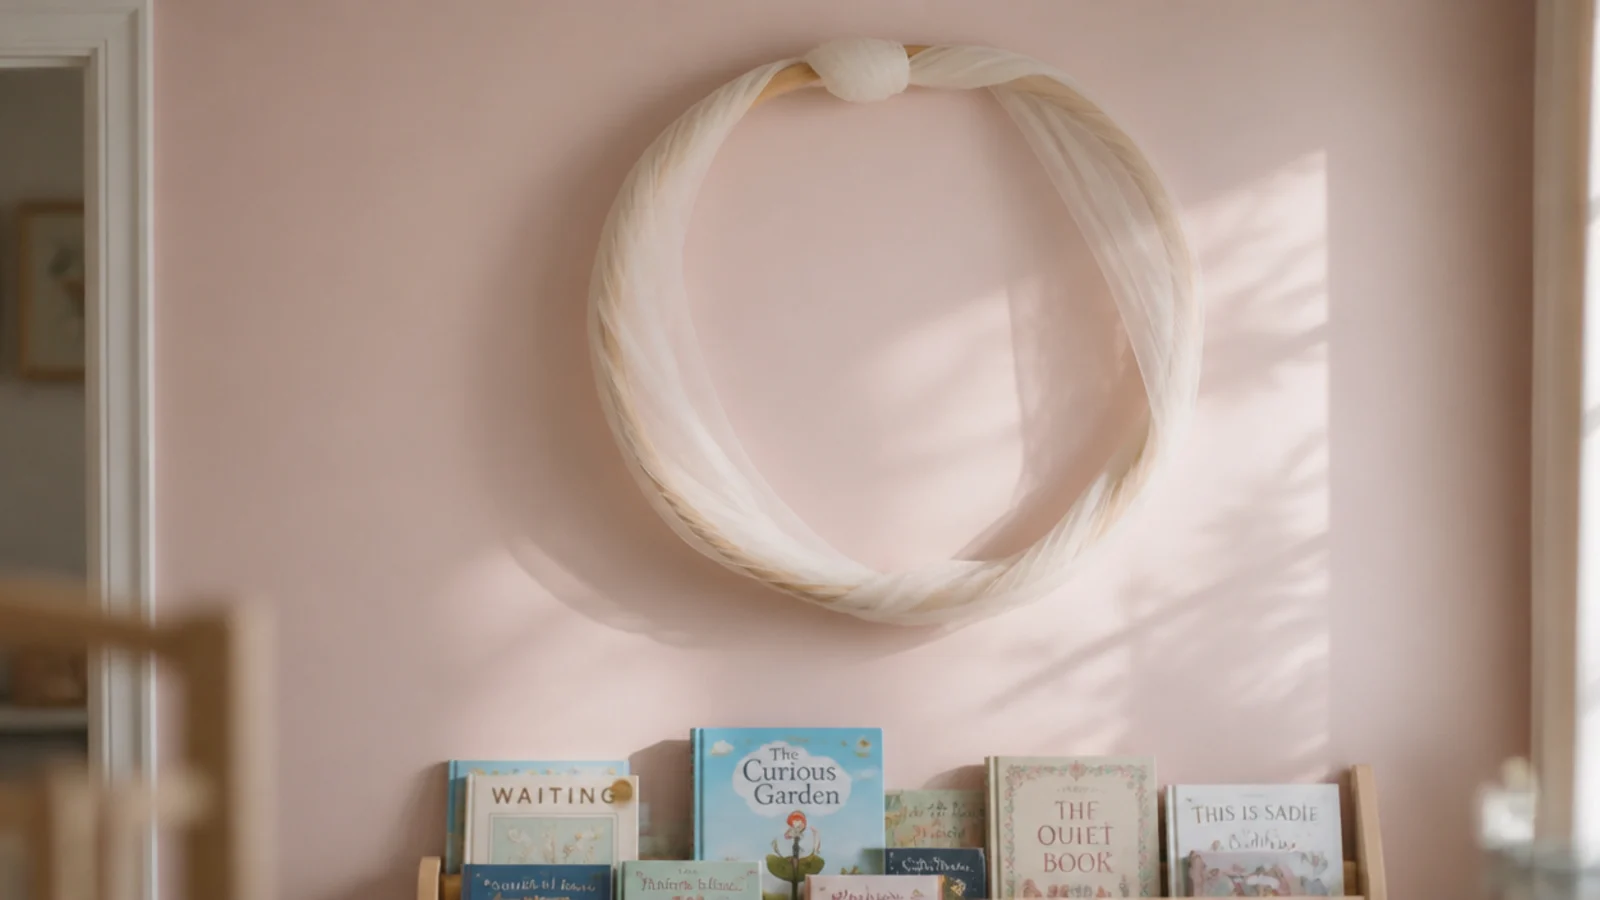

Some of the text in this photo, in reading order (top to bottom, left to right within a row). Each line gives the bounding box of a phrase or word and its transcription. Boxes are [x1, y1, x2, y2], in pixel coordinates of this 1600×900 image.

[769, 747, 799, 760] The
[743, 758, 837, 782] Curious
[492, 787, 616, 804] WAITING
[753, 783, 840, 806] Garden
[1054, 800, 1099, 820] THE
[1191, 804, 1318, 824] THIS IS SADIE
[1043, 851, 1113, 874] BOOK
